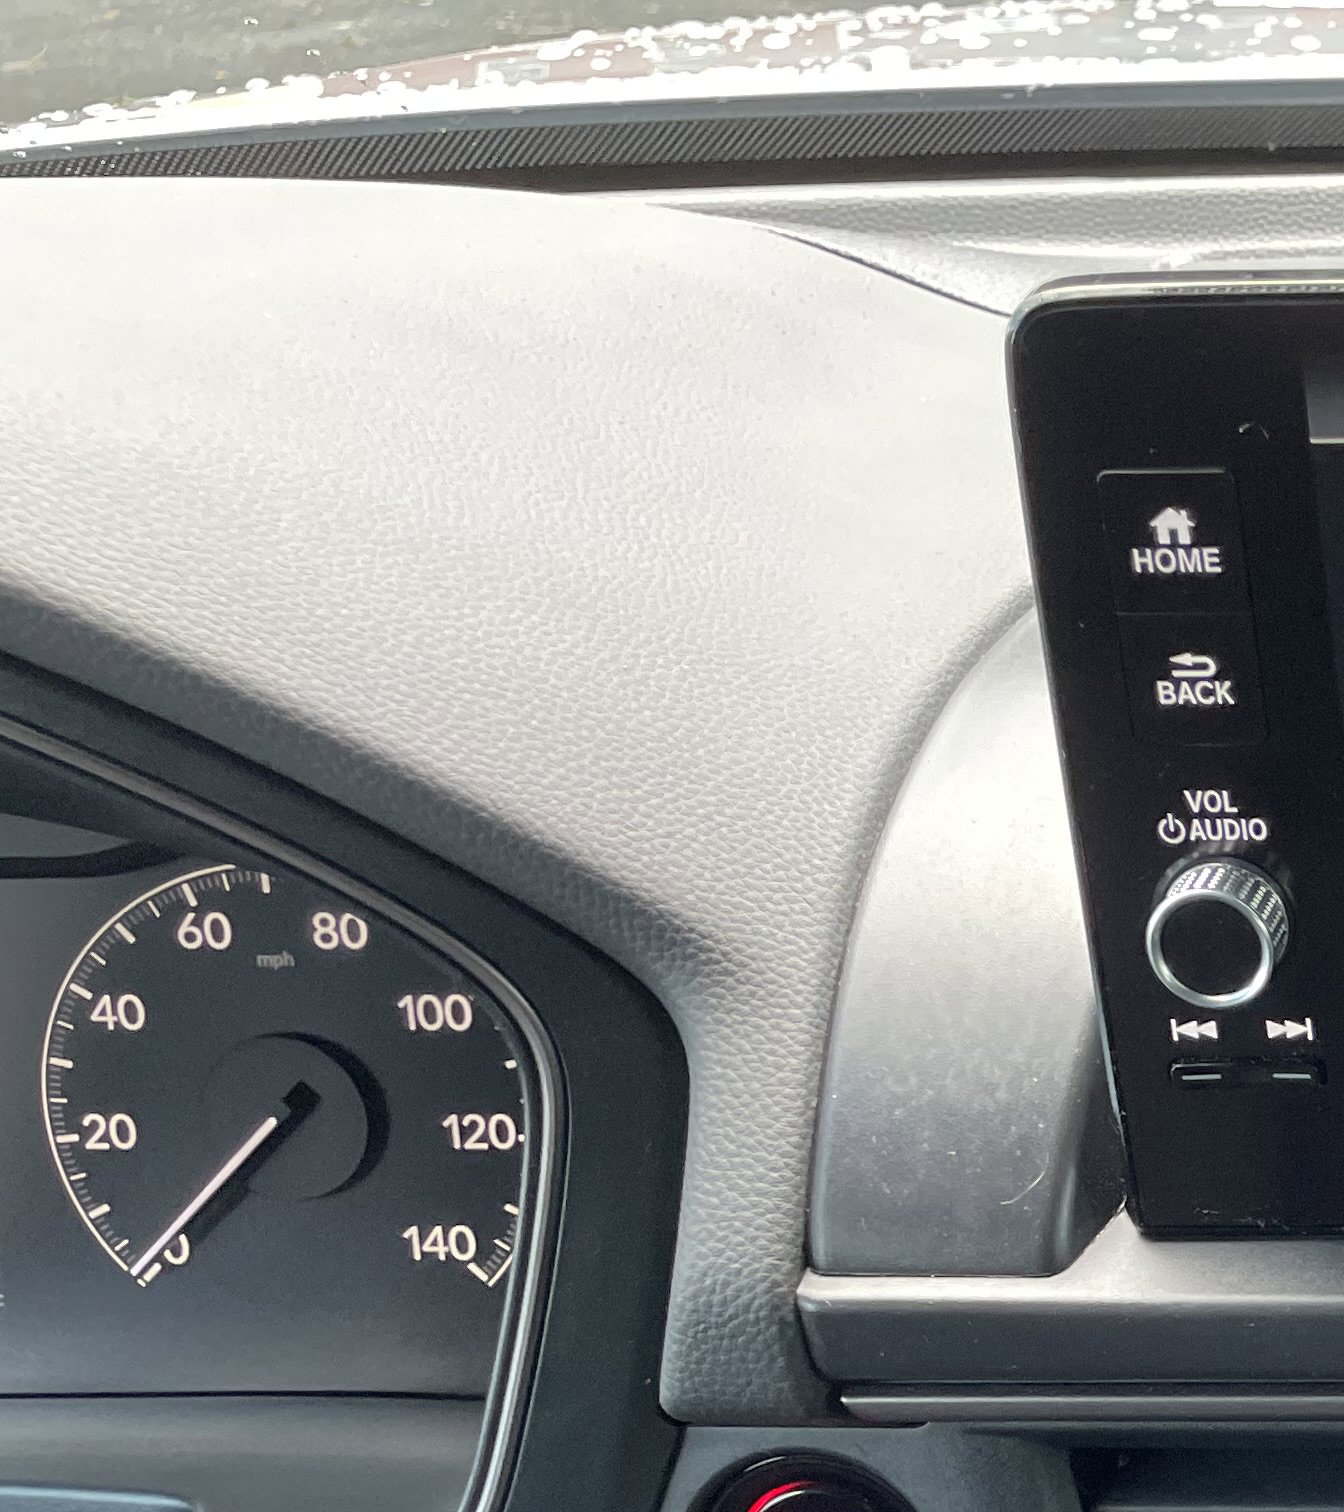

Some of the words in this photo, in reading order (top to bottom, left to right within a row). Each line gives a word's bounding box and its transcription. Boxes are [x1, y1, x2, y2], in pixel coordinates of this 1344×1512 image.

[1131, 547, 1222, 574] HOME
[1156, 680, 1236, 706] BACK
[1183, 790, 1238, 814] VOL
[1189, 818, 1268, 842] AUDIO
[177, 912, 232, 950] 60
[312, 912, 368, 950] 80
[256, 950, 296, 971] mph
[90, 994, 145, 1031] 40
[397, 994, 472, 1031] 100
[81, 1113, 136, 1150] 20
[442, 1113, 516, 1150] 120
[402, 1225, 476, 1261] 140
